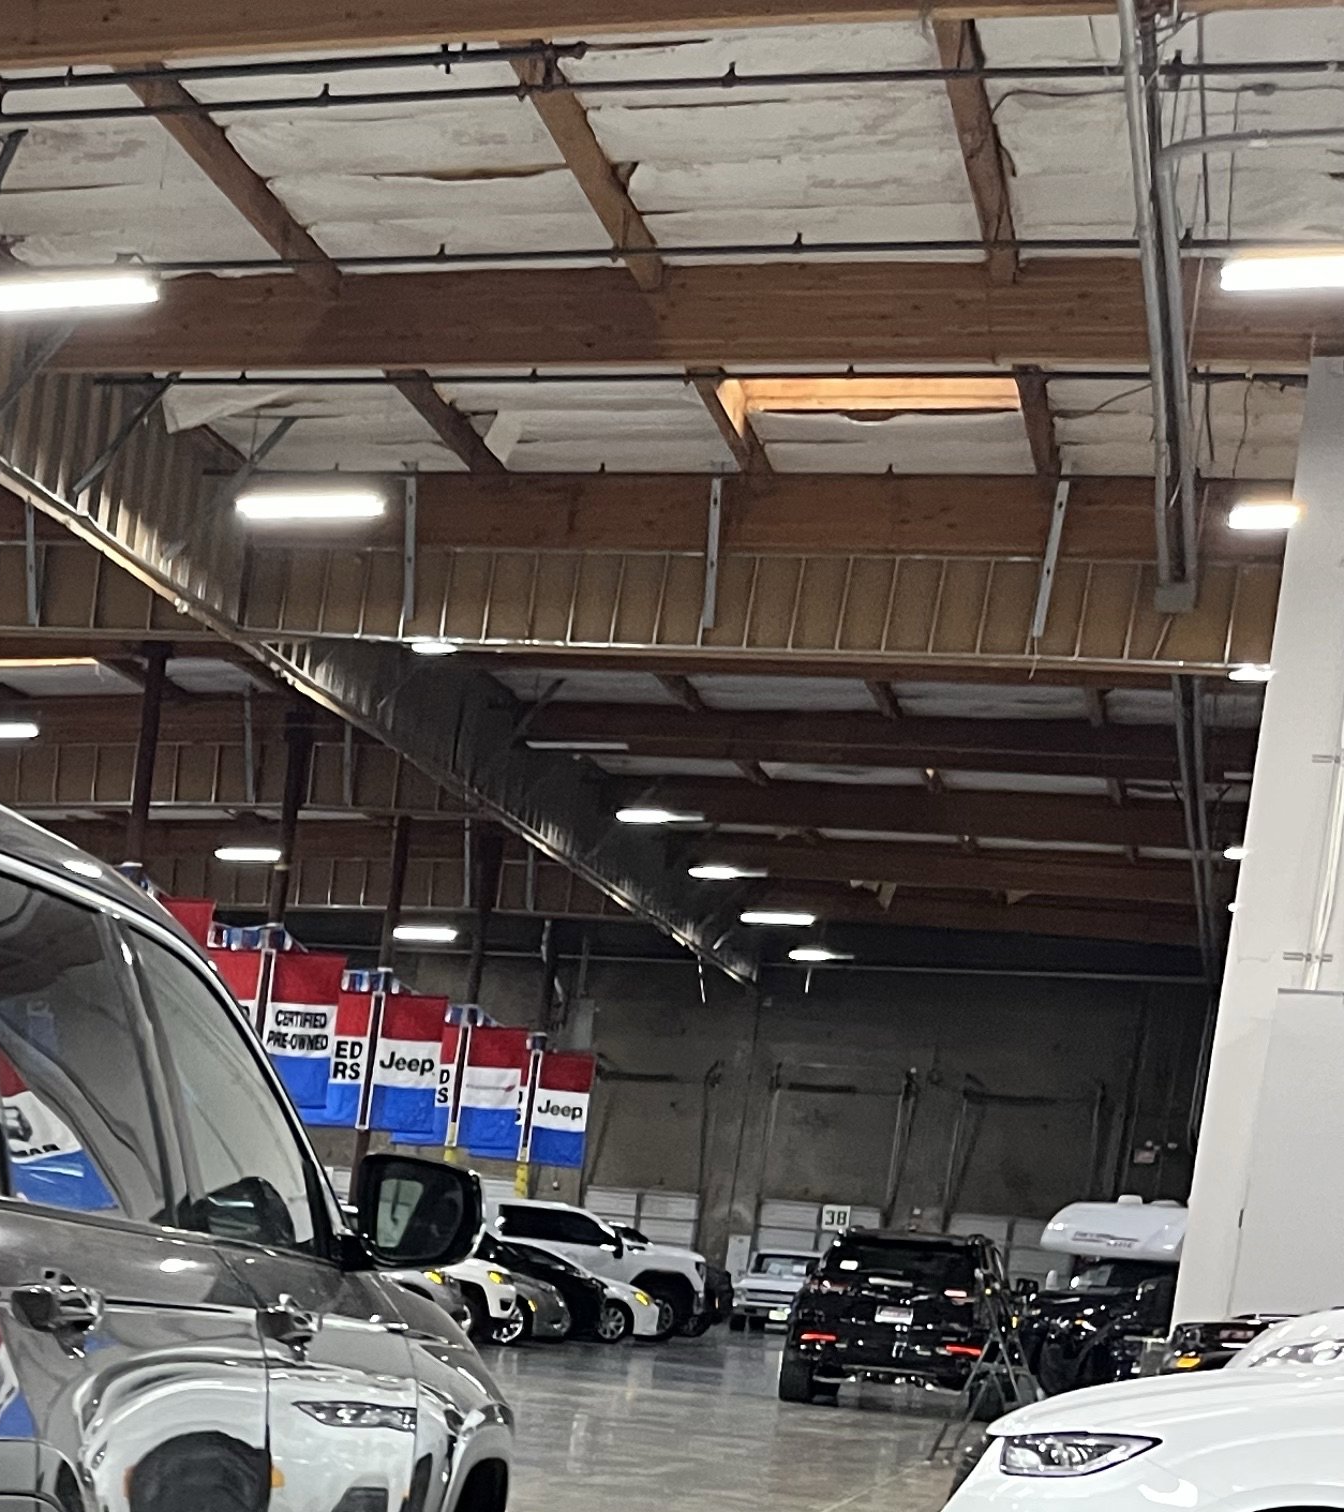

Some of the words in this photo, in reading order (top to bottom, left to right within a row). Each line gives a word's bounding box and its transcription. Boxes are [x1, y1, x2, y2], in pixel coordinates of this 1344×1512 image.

[379, 1051, 435, 1076] Jeep
[537, 1100, 583, 1121] Jeep
[824, 1210, 848, 1226] 38
